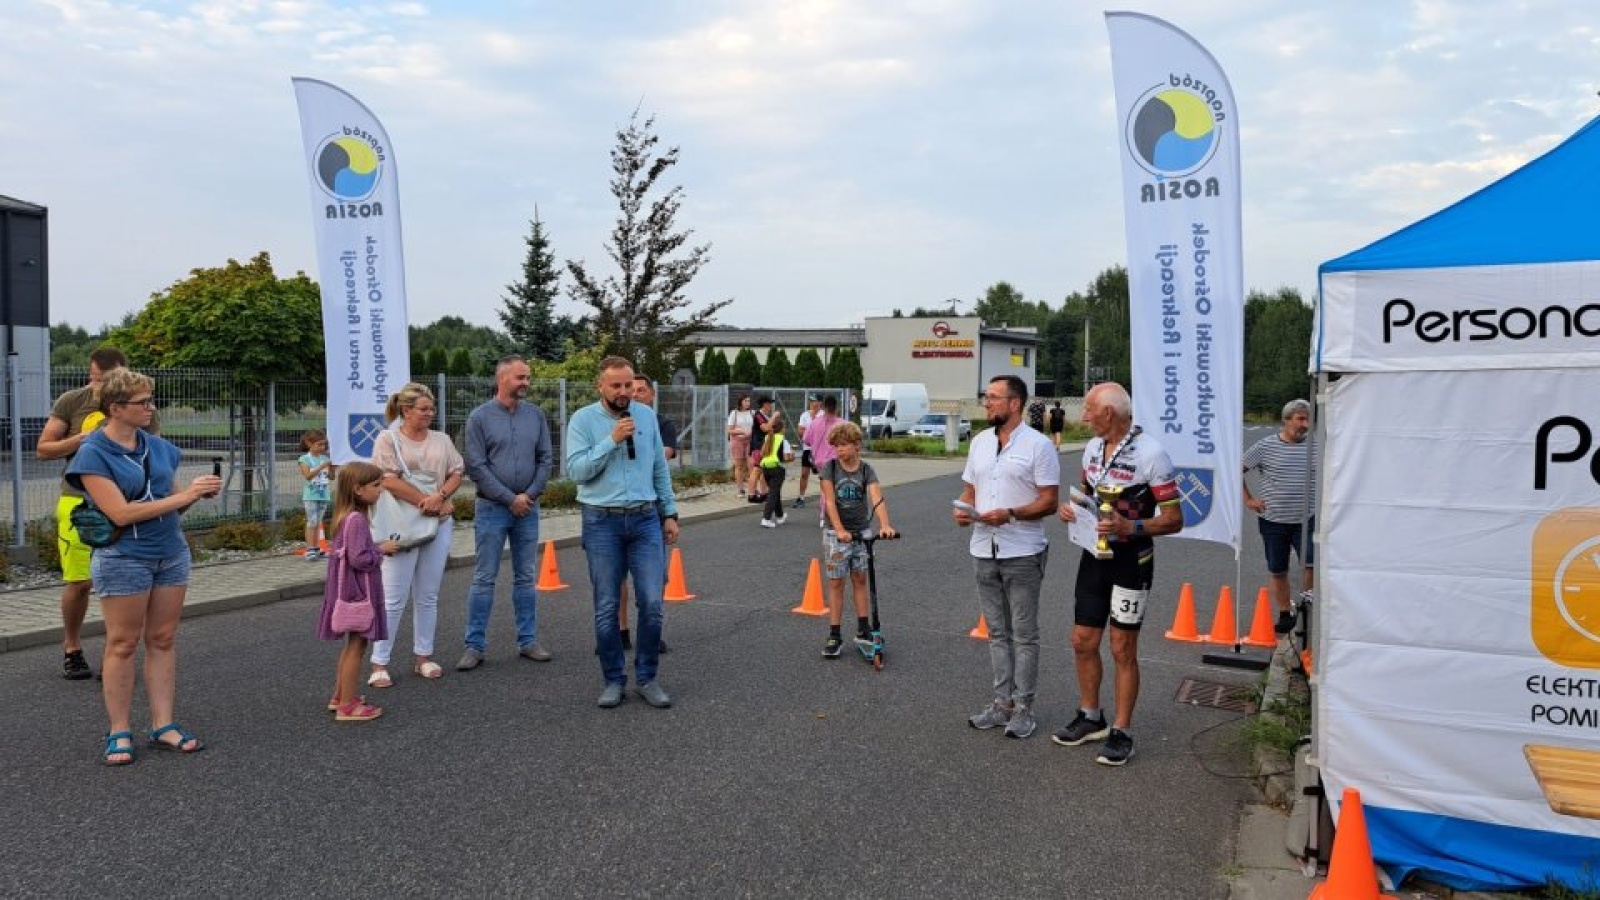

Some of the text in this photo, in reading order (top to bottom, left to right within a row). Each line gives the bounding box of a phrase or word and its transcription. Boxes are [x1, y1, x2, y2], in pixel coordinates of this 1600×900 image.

[1534, 415, 1600, 490] P
[1119, 599, 1139, 614] 31
[1526, 674, 1600, 700] ELEKT
